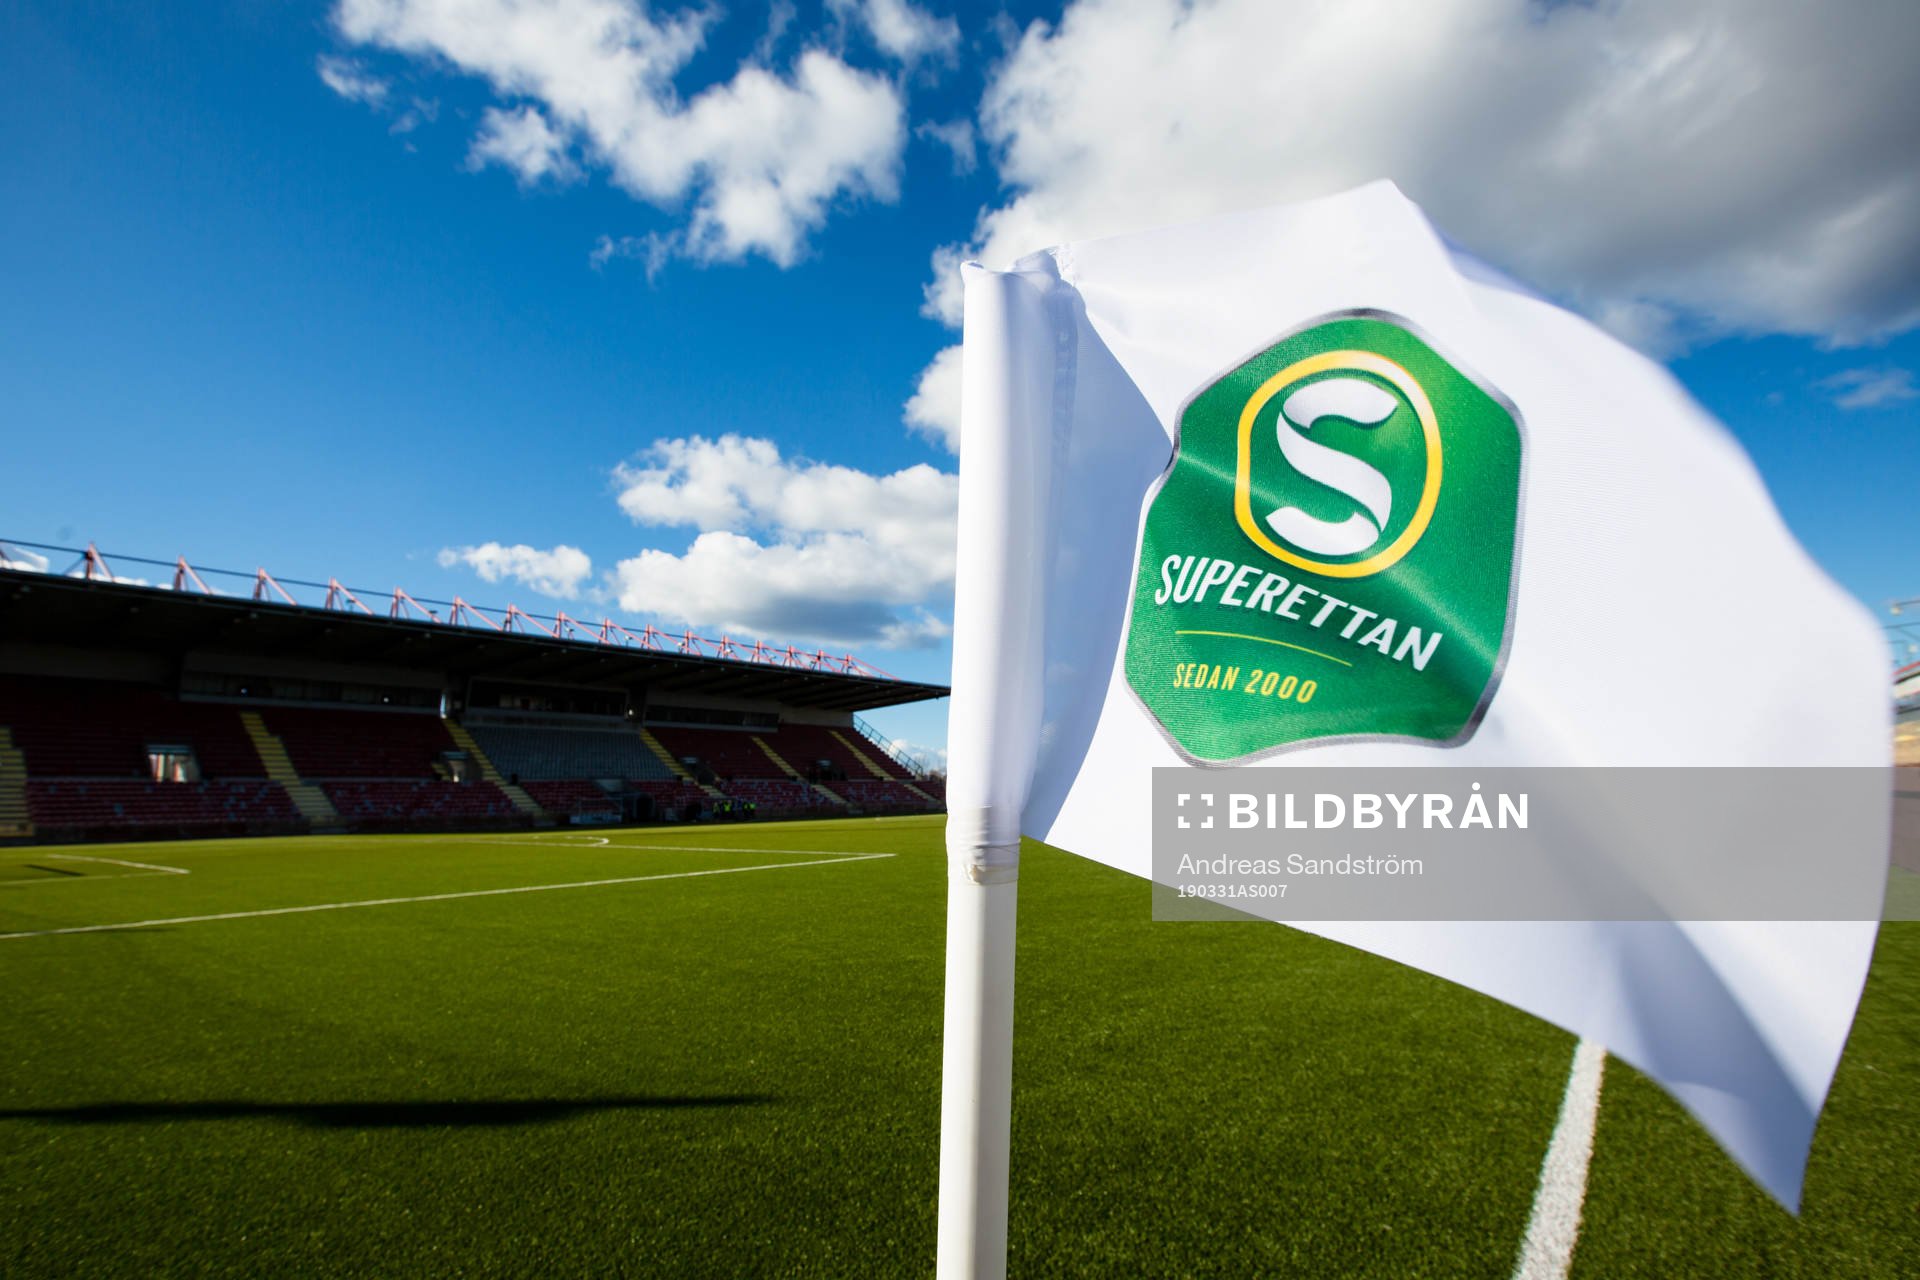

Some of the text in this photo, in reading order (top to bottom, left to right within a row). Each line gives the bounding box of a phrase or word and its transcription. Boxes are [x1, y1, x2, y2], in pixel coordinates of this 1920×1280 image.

[1266, 378, 1399, 556] S
[1155, 554, 1443, 672] SUPERETTAN
[1173, 663, 1318, 704] SEDAN 2000
